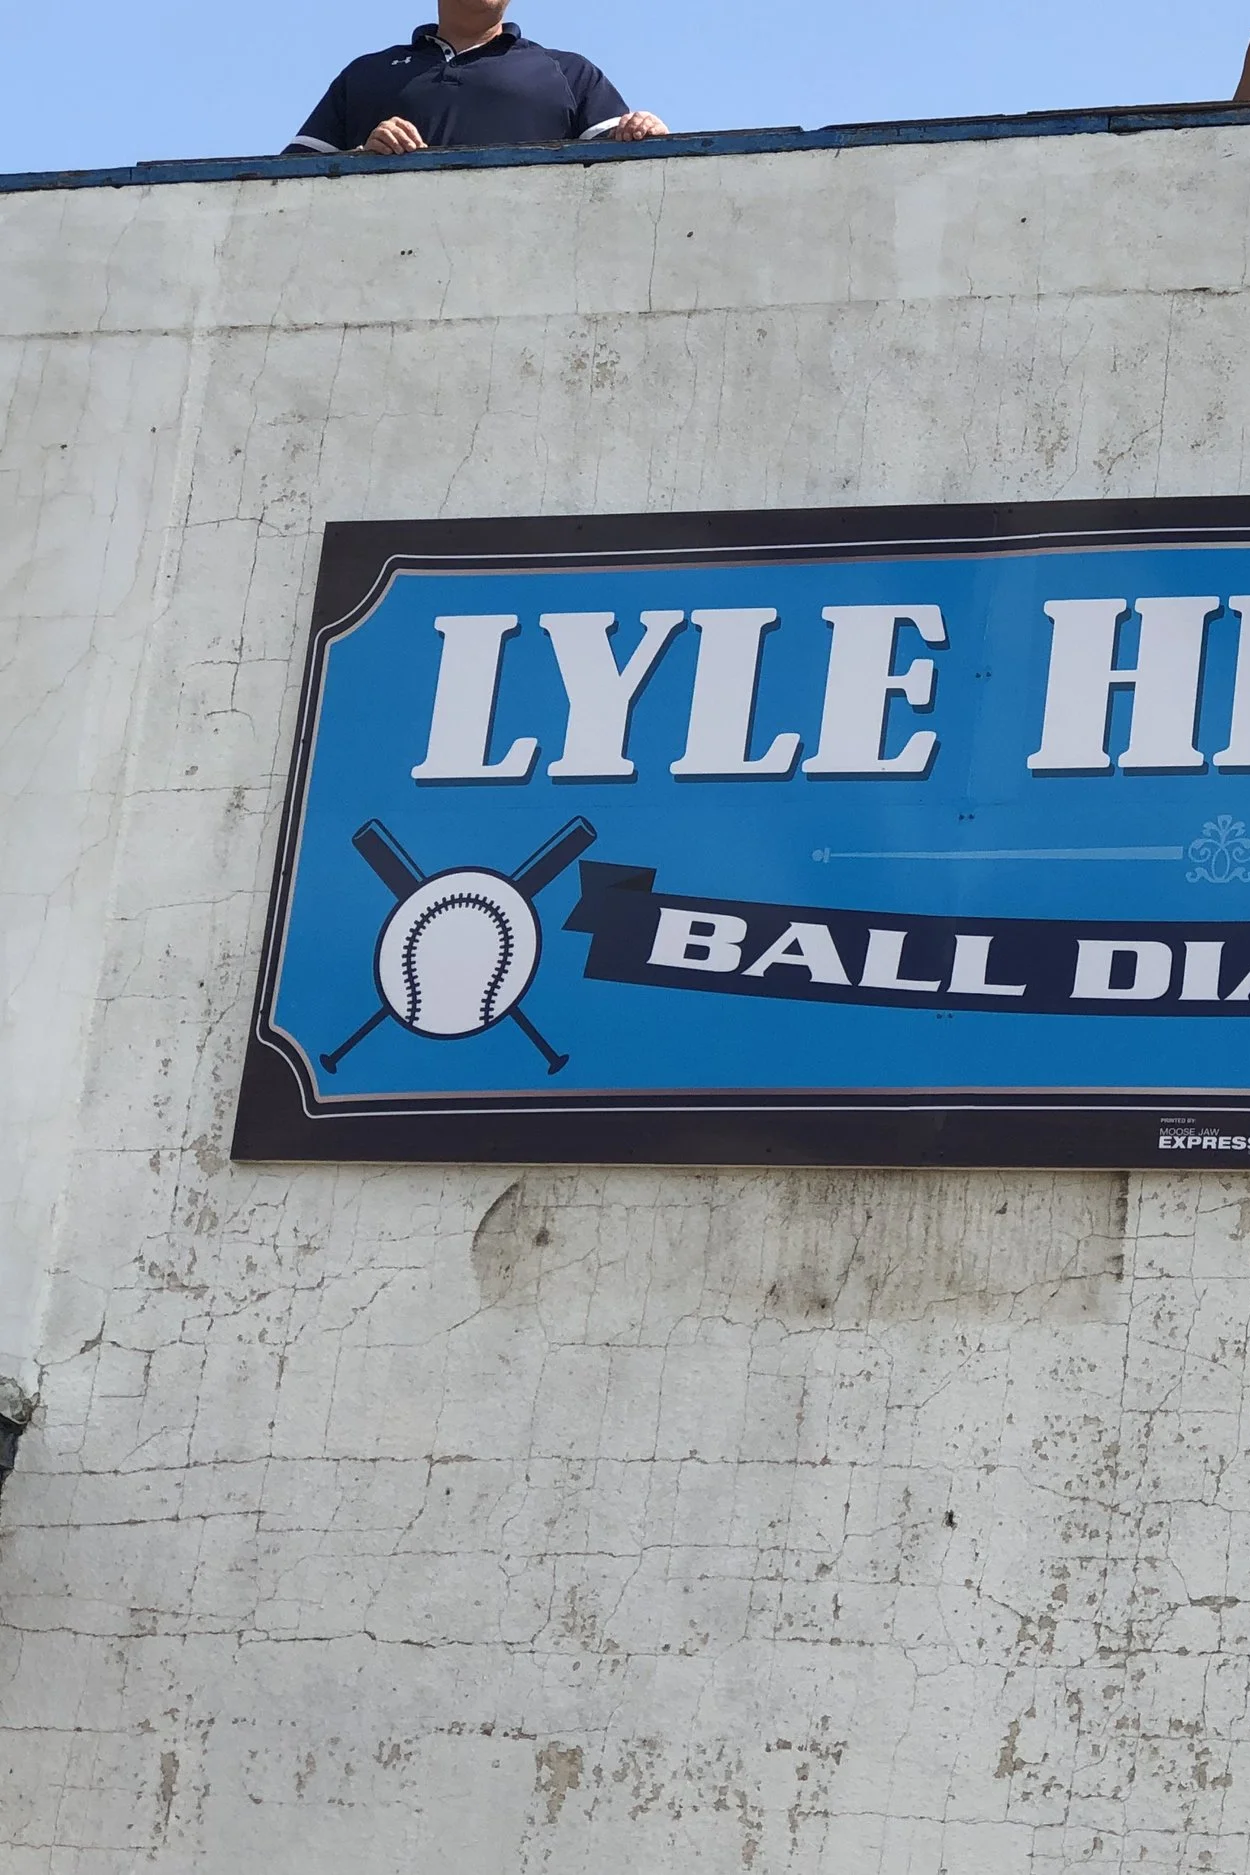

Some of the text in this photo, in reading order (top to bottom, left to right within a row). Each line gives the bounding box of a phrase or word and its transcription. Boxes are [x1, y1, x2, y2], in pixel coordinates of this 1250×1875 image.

[412, 605, 947, 782] LYLE
[647, 908, 1027, 997] BALL
[1159, 1127, 1220, 1136] MOOSE JAW
